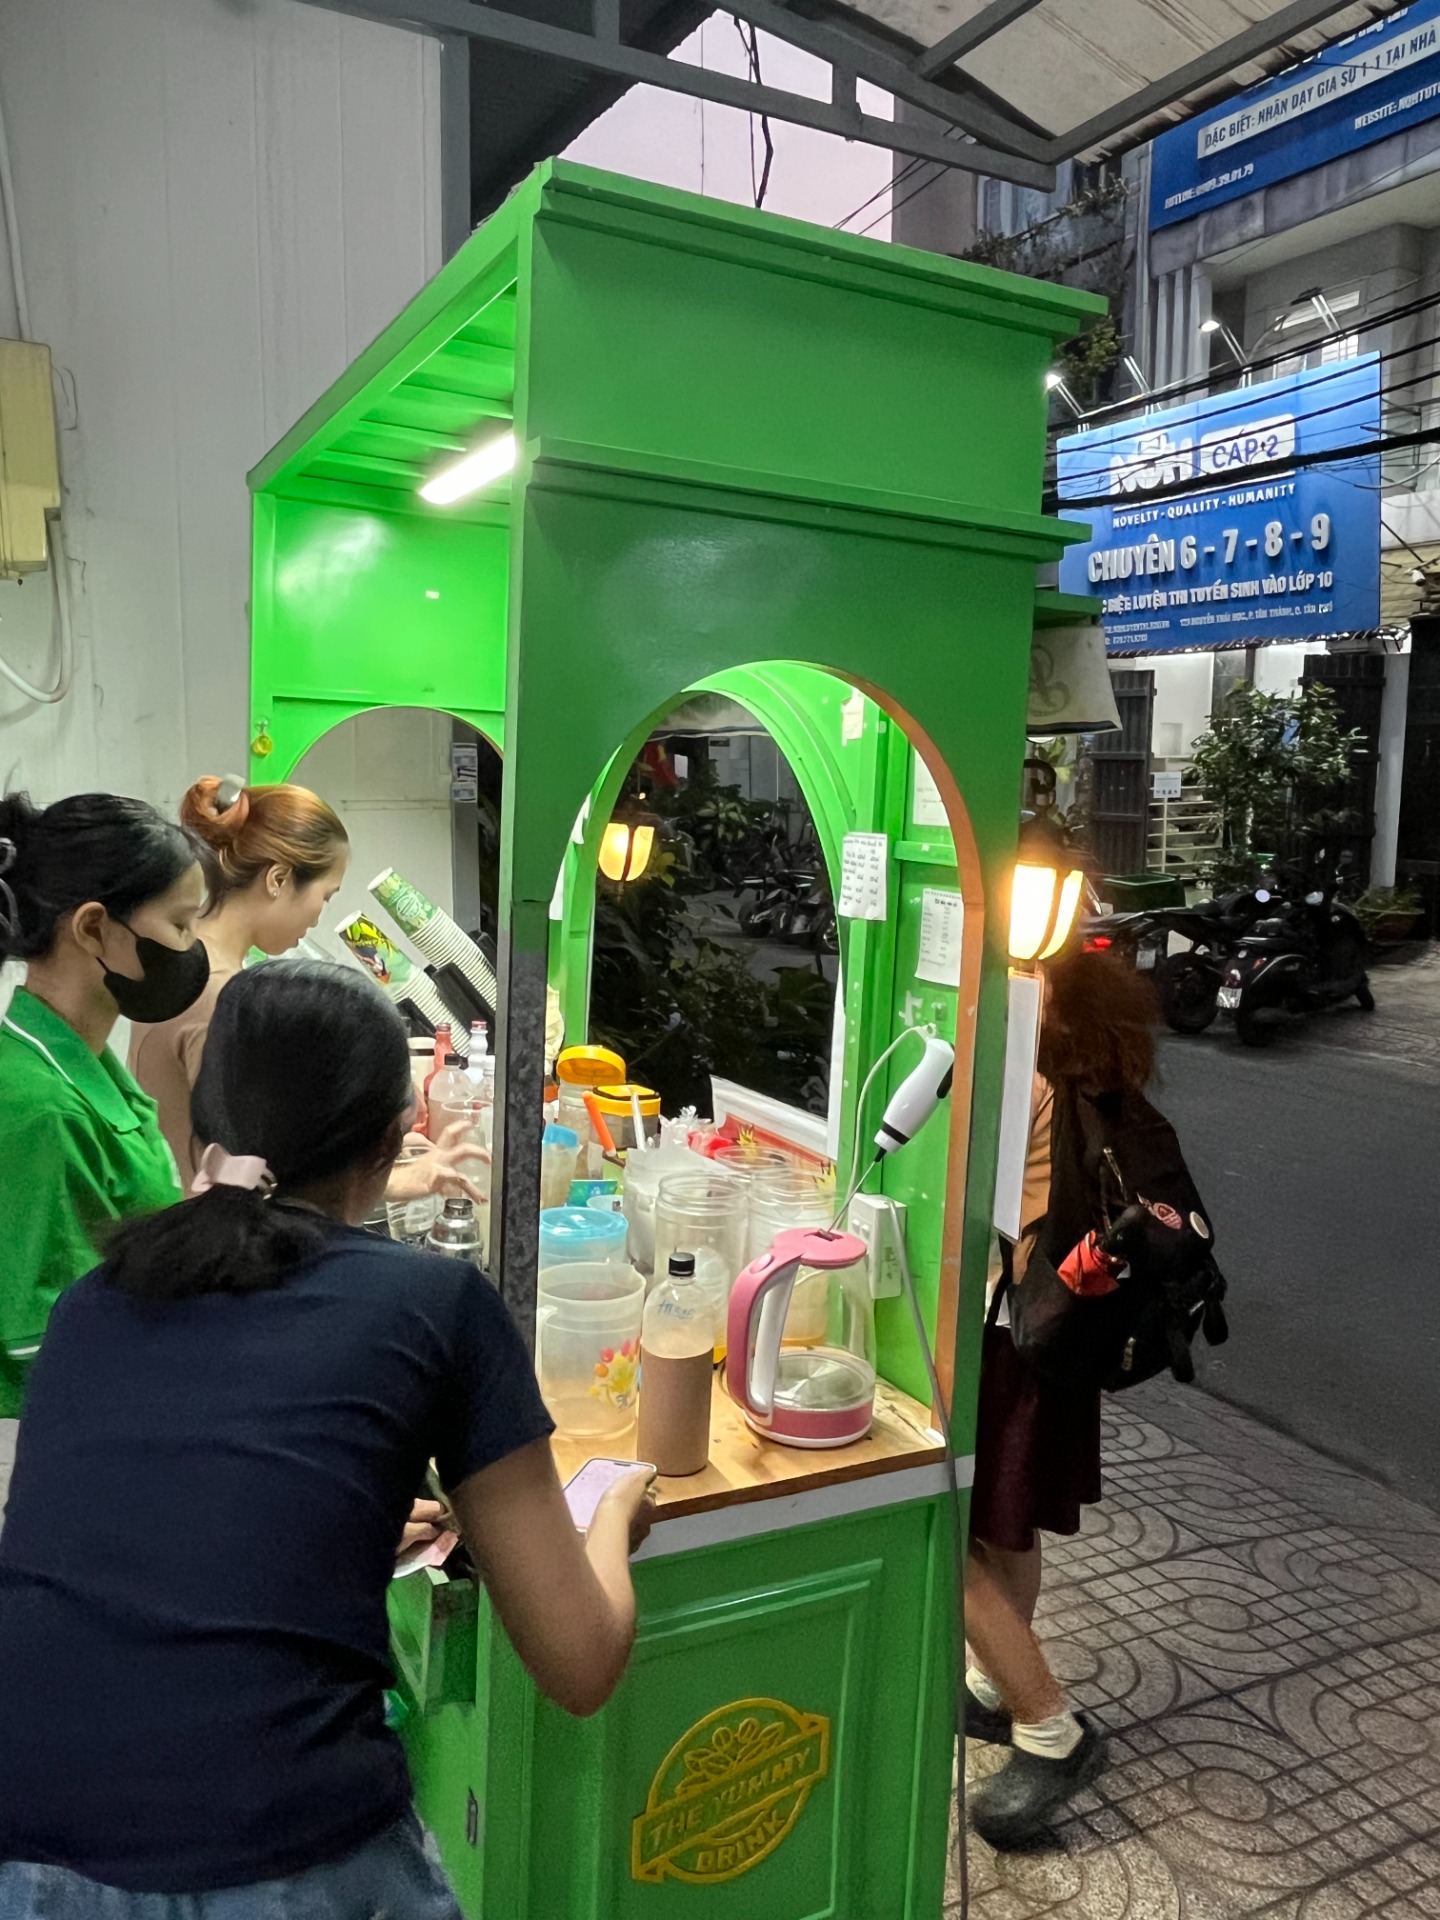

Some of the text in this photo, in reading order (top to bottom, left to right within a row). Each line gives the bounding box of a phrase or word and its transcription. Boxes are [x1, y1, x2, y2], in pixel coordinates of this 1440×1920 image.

[1317, 76, 1337, 98] GIA
[1267, 435, 1279, 459] 2
[1113, 510, 1158, 528] NOVELTY
[1167, 498, 1220, 518] QUALITY
[1228, 483, 1296, 507] HUMANITY
[1088, 533, 1175, 583] CHUYÊN
[1180, 535, 1197, 569] 6
[1222, 529, 1239, 564] 7
[1264, 521, 1283, 557] 8
[1311, 513, 1331, 550] 9
[1168, 589, 1188, 605] THI
[1230, 580, 1259, 598] SINH
[1262, 574, 1286, 594] VÀO
[1289, 570, 1315, 591] LỚP
[1317, 571, 1333, 588] 10
[651, 1747, 811, 1852] THE YUMMY
[696, 1810, 786, 1872] DRINK
